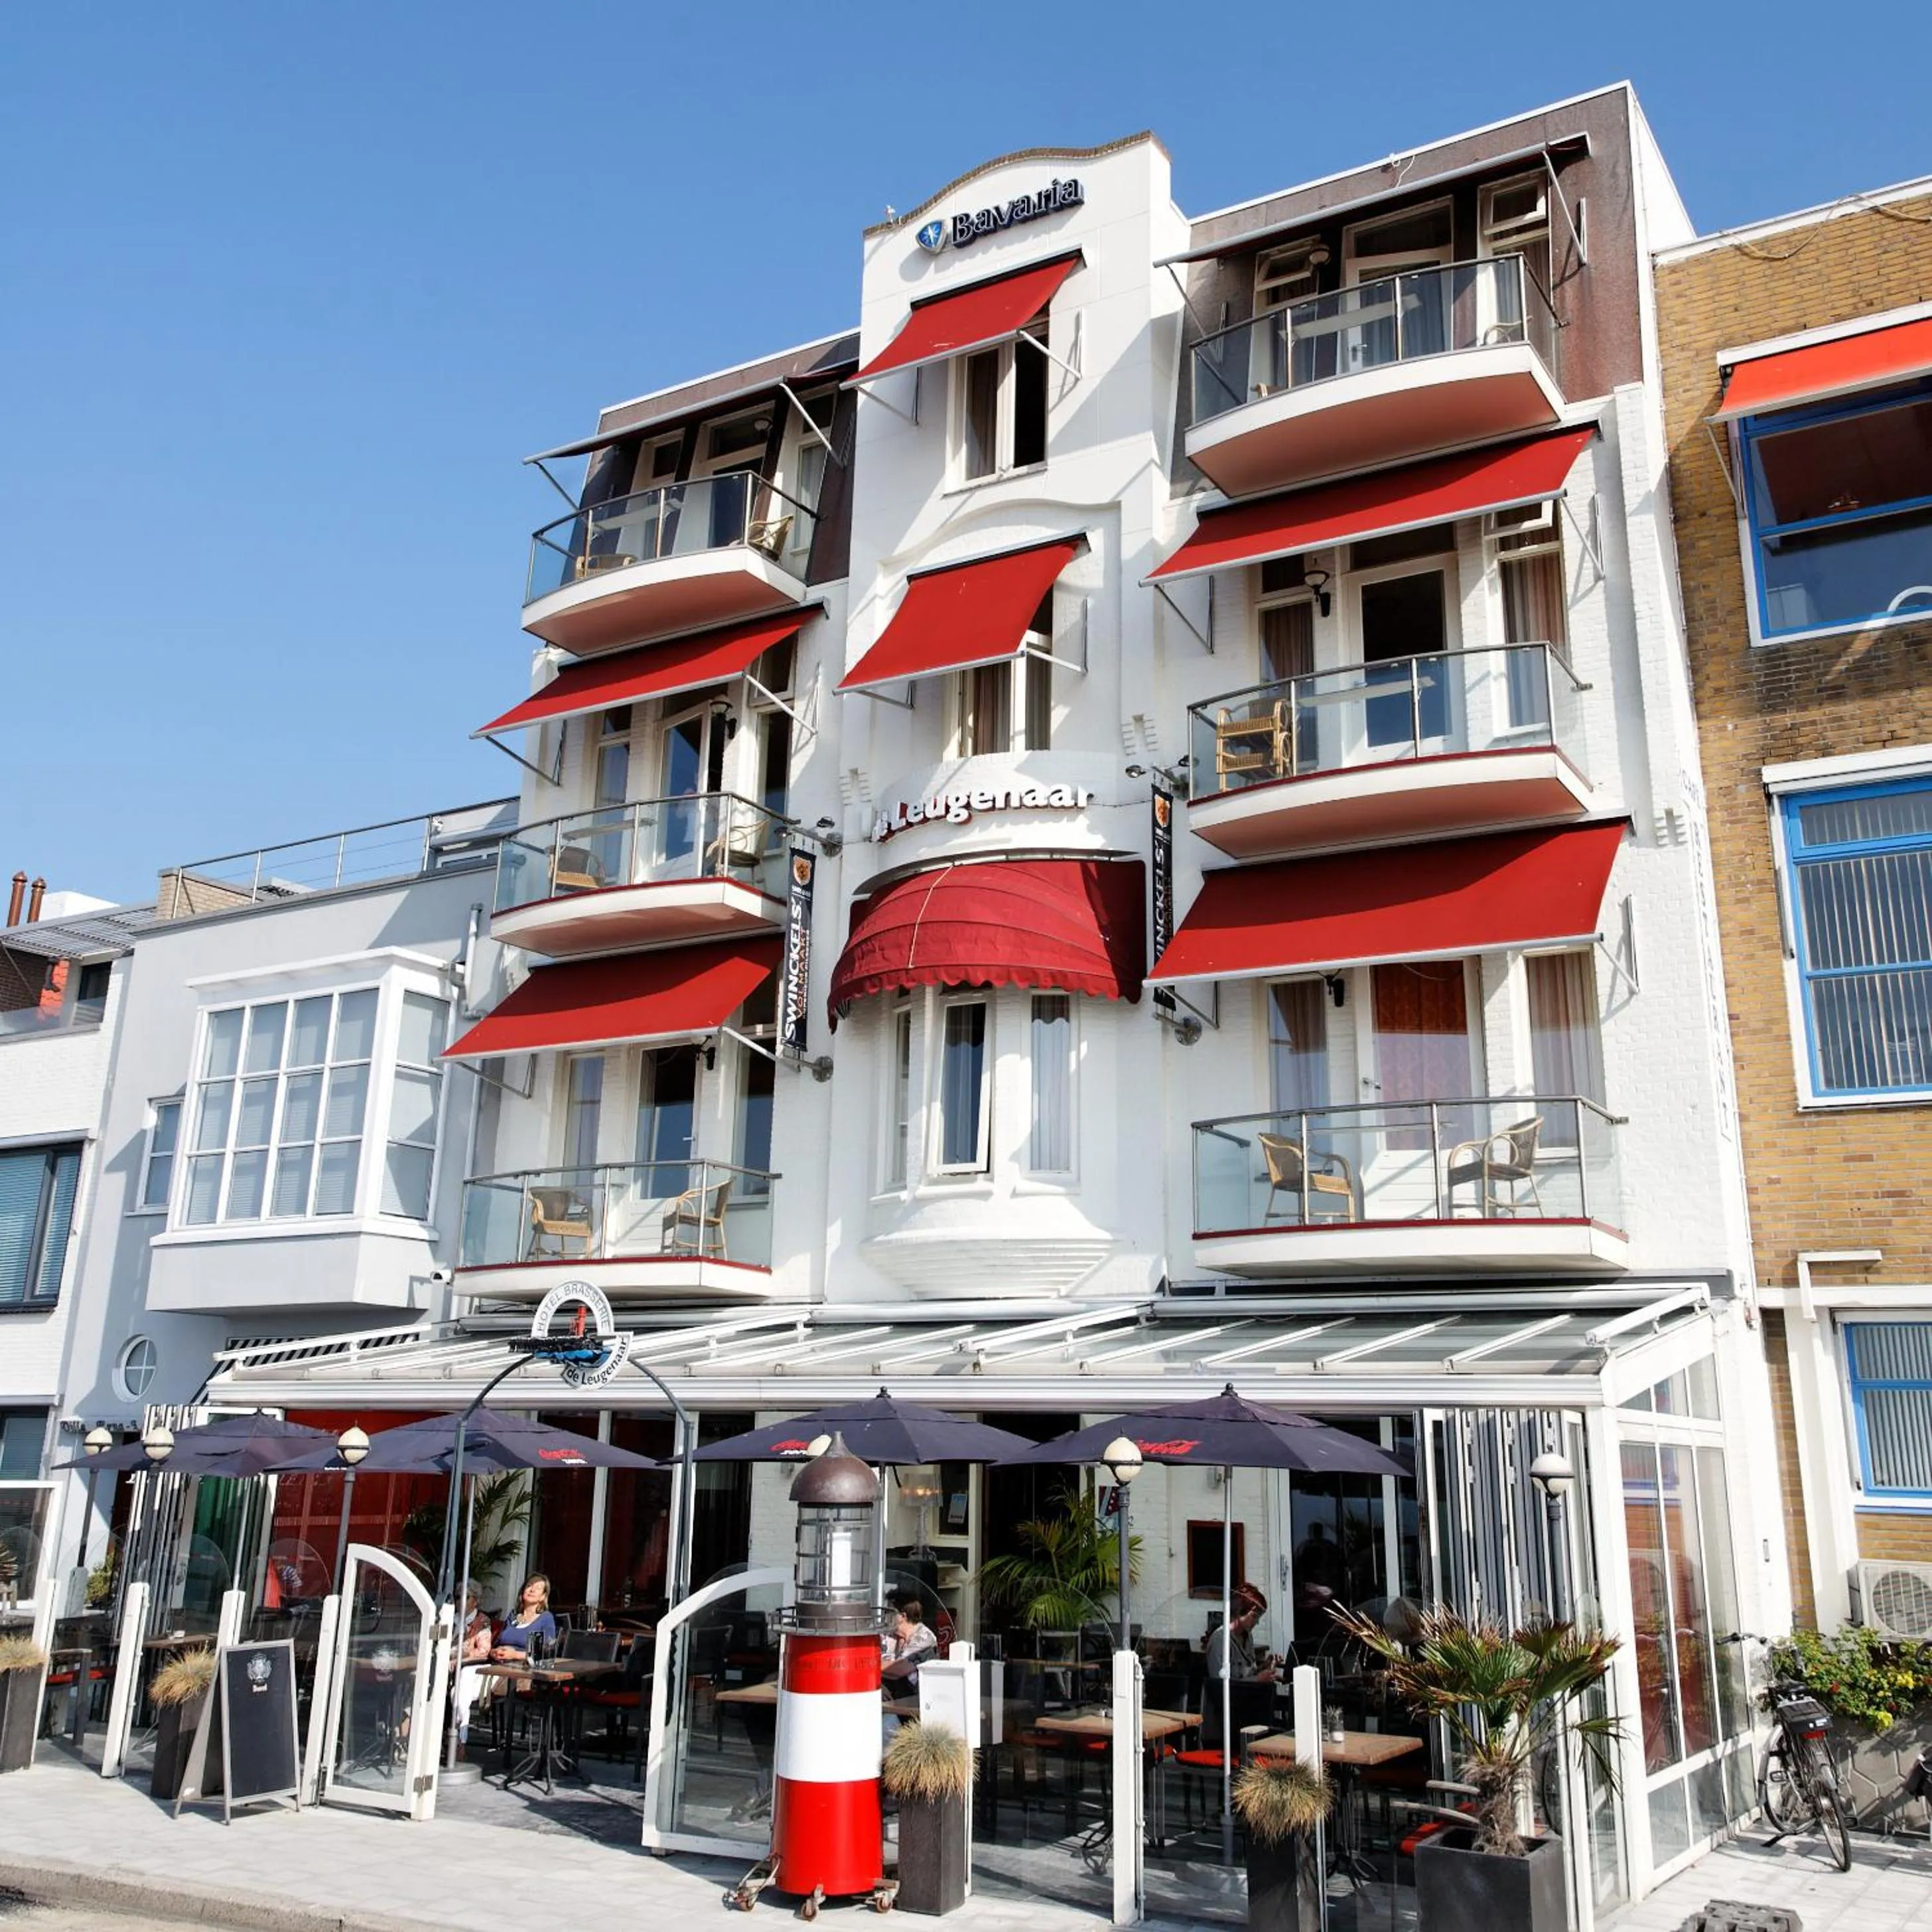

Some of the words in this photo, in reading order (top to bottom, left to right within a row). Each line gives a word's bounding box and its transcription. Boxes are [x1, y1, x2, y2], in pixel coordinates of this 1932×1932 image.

[951, 178, 1084, 248] Bavaria
[890, 784, 1095, 829] Leugenaar
[537, 1292, 562, 1332] HOTEL
[564, 1284, 610, 1328] BRASSERIE
[567, 1368, 580, 1381] de
[581, 1337, 628, 1385] Leugenaar
